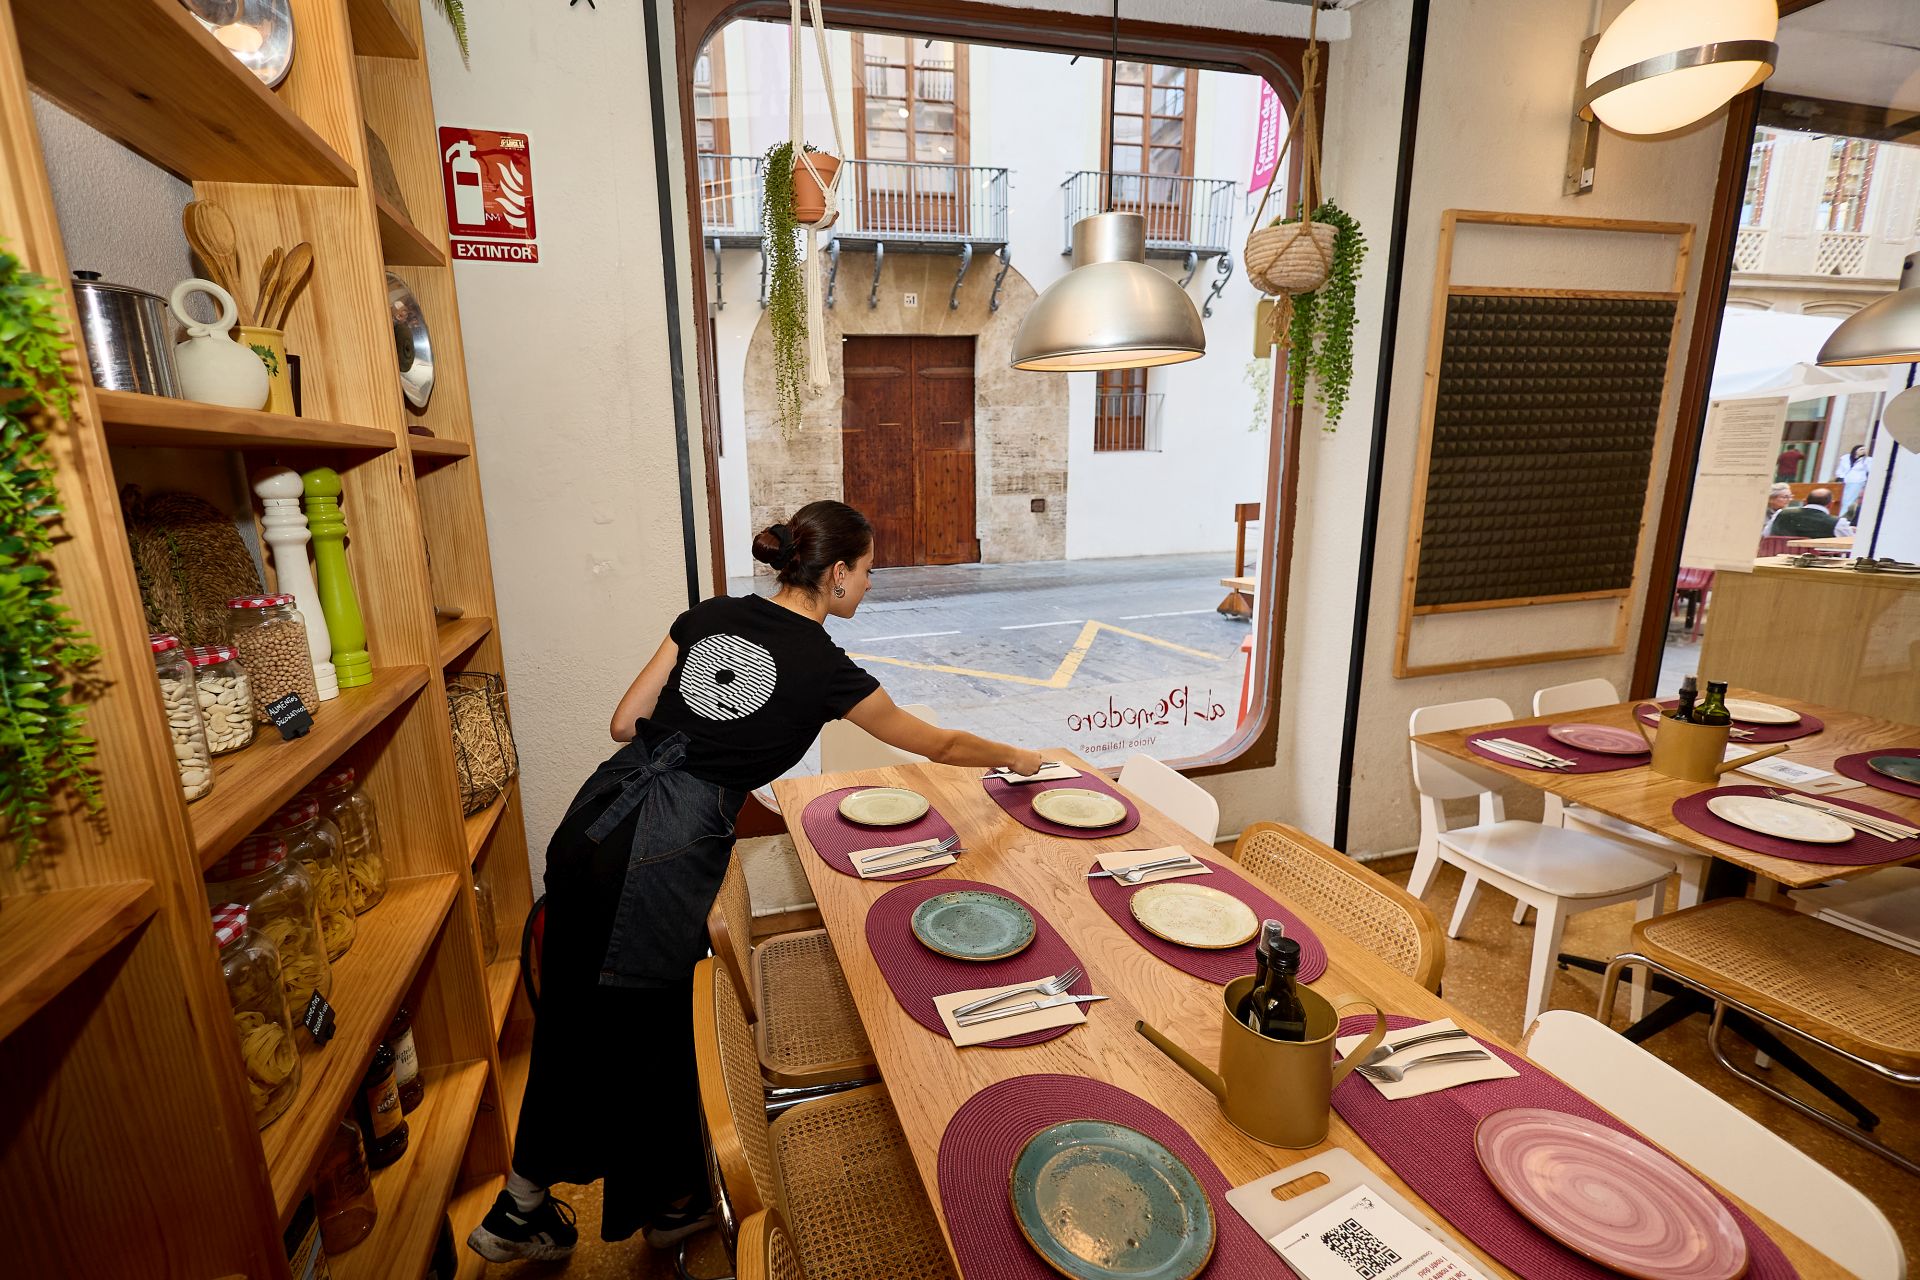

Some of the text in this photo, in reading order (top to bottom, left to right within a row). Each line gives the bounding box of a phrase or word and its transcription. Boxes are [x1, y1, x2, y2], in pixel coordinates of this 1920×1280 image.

[1261, 97, 1271, 119] de
[1255, 119, 1269, 176] Centro
[457, 244, 532, 260] EXTINTOR
